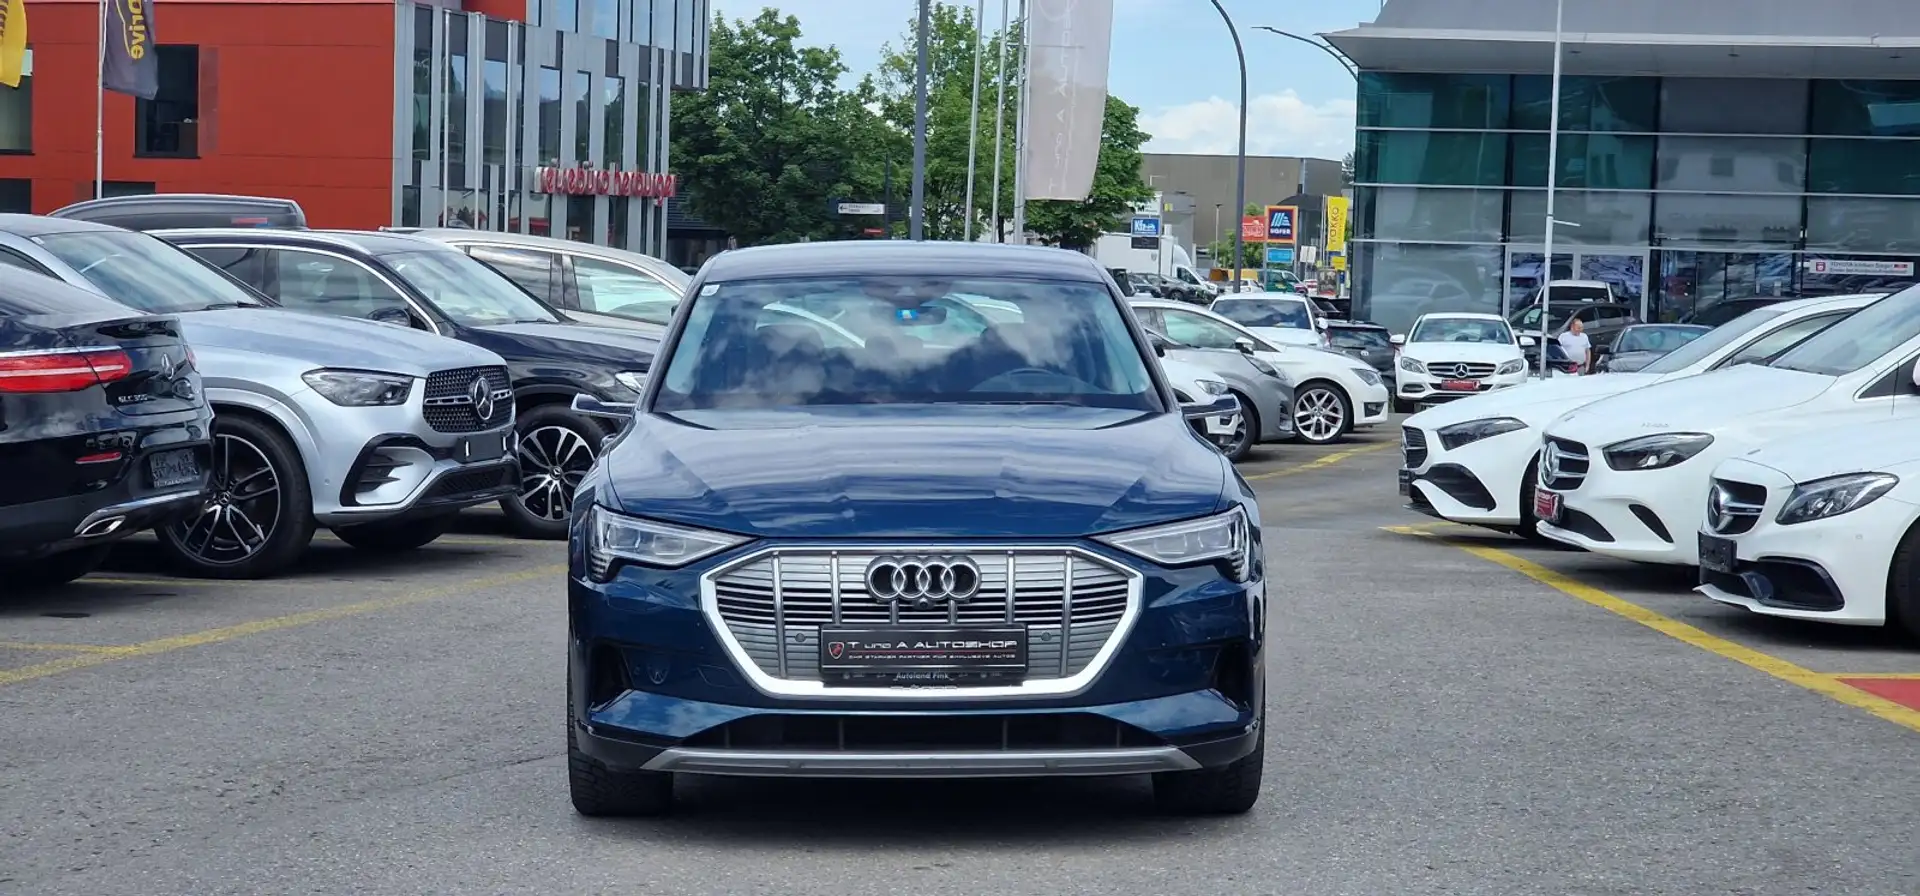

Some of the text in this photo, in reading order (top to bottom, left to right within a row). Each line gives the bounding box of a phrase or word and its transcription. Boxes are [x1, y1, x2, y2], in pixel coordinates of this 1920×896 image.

[846, 641, 860, 649] T
[896, 641, 908, 649] A
[914, 640, 1017, 649] AUTOSHOP
[896, 672, 930, 680] Autoland
